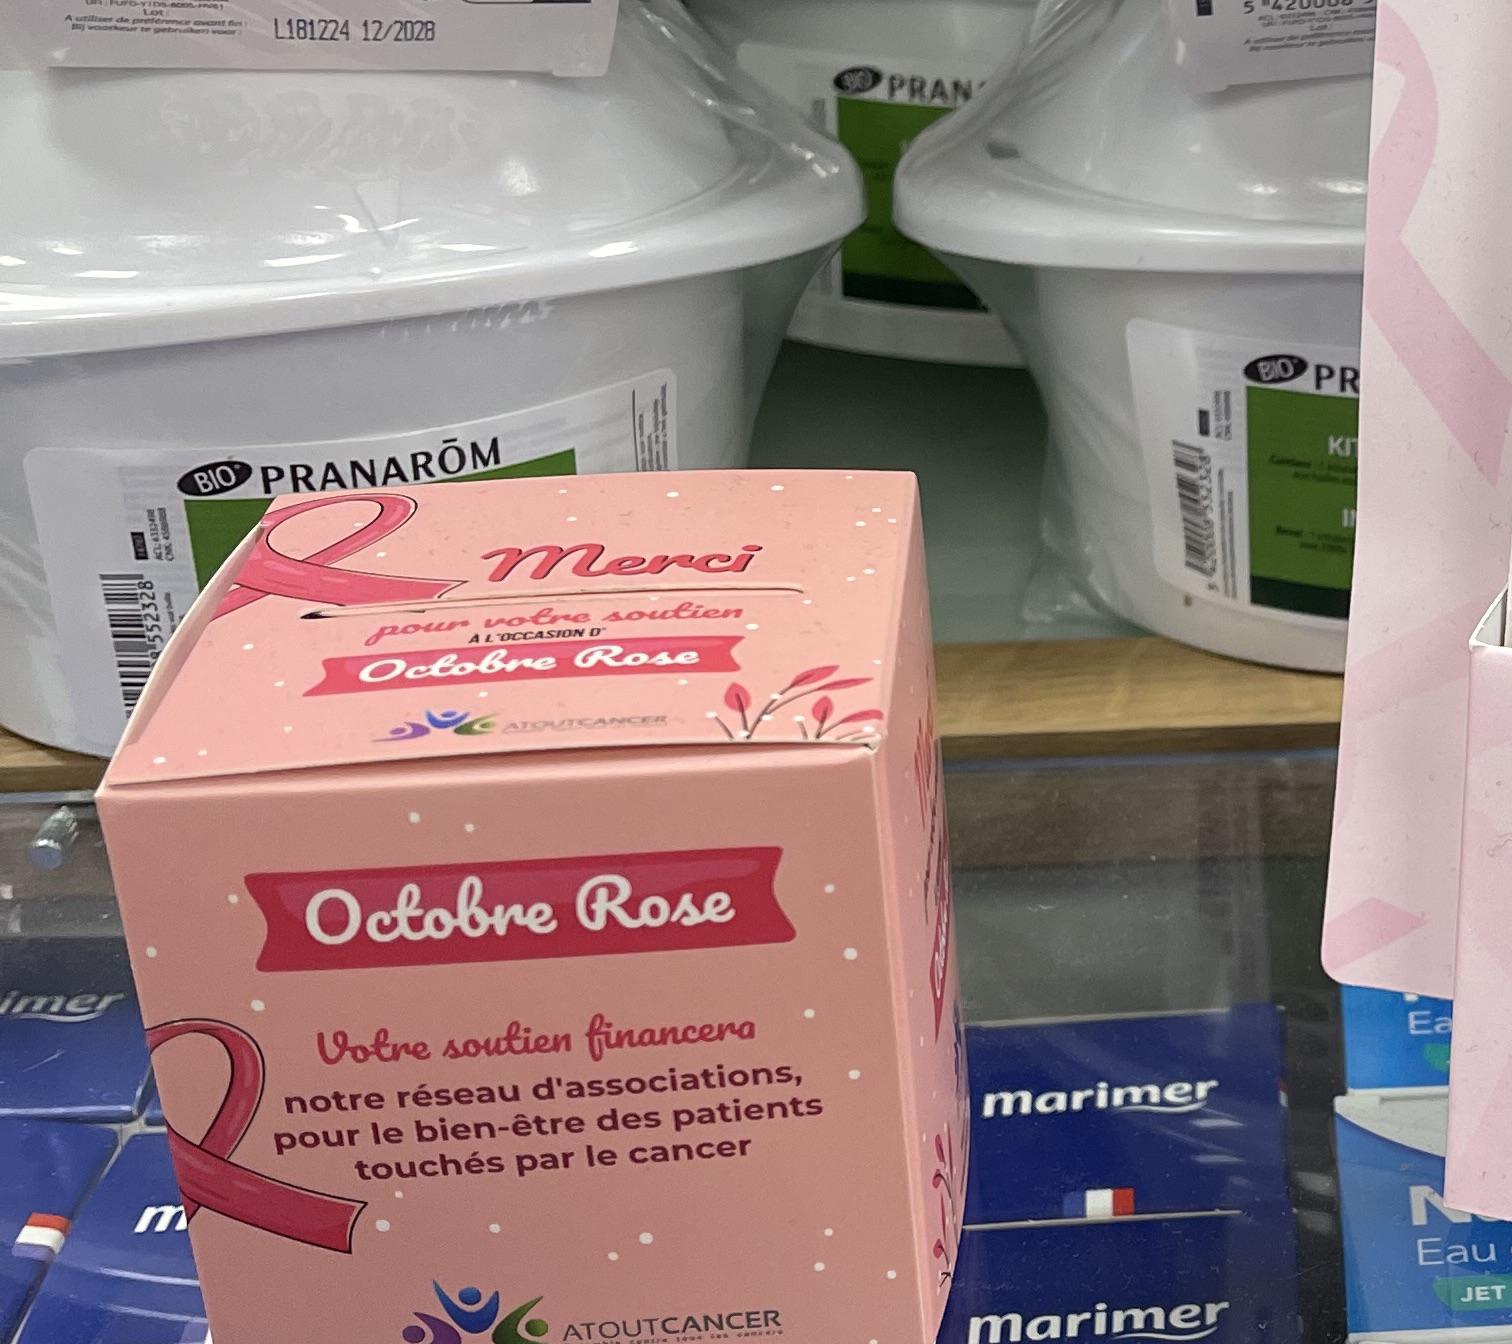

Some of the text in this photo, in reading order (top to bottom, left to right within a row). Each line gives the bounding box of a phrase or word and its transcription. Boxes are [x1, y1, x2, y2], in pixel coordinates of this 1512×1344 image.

[363, 20, 436, 43] 12/2028
[192, 464, 238, 494] BIO
[482, 542, 763, 584] Merci
[363, 600, 745, 647] pour votre soutien
[357, 643, 700, 684] Octobre Rose
[304, 872, 737, 946] Octobre Rose
[316, 1012, 756, 1066] Votre soutien financera
[284, 1061, 803, 1114] notre réseau d'associations,
[981, 1077, 1219, 1117] marimer
[273, 1093, 825, 1155] pour le bien-être des patients
[354, 1136, 753, 1181] touchés par le cancer
[1460, 1284, 1506, 1303] JET
[562, 1310, 783, 1342] ATOUTCANCER
